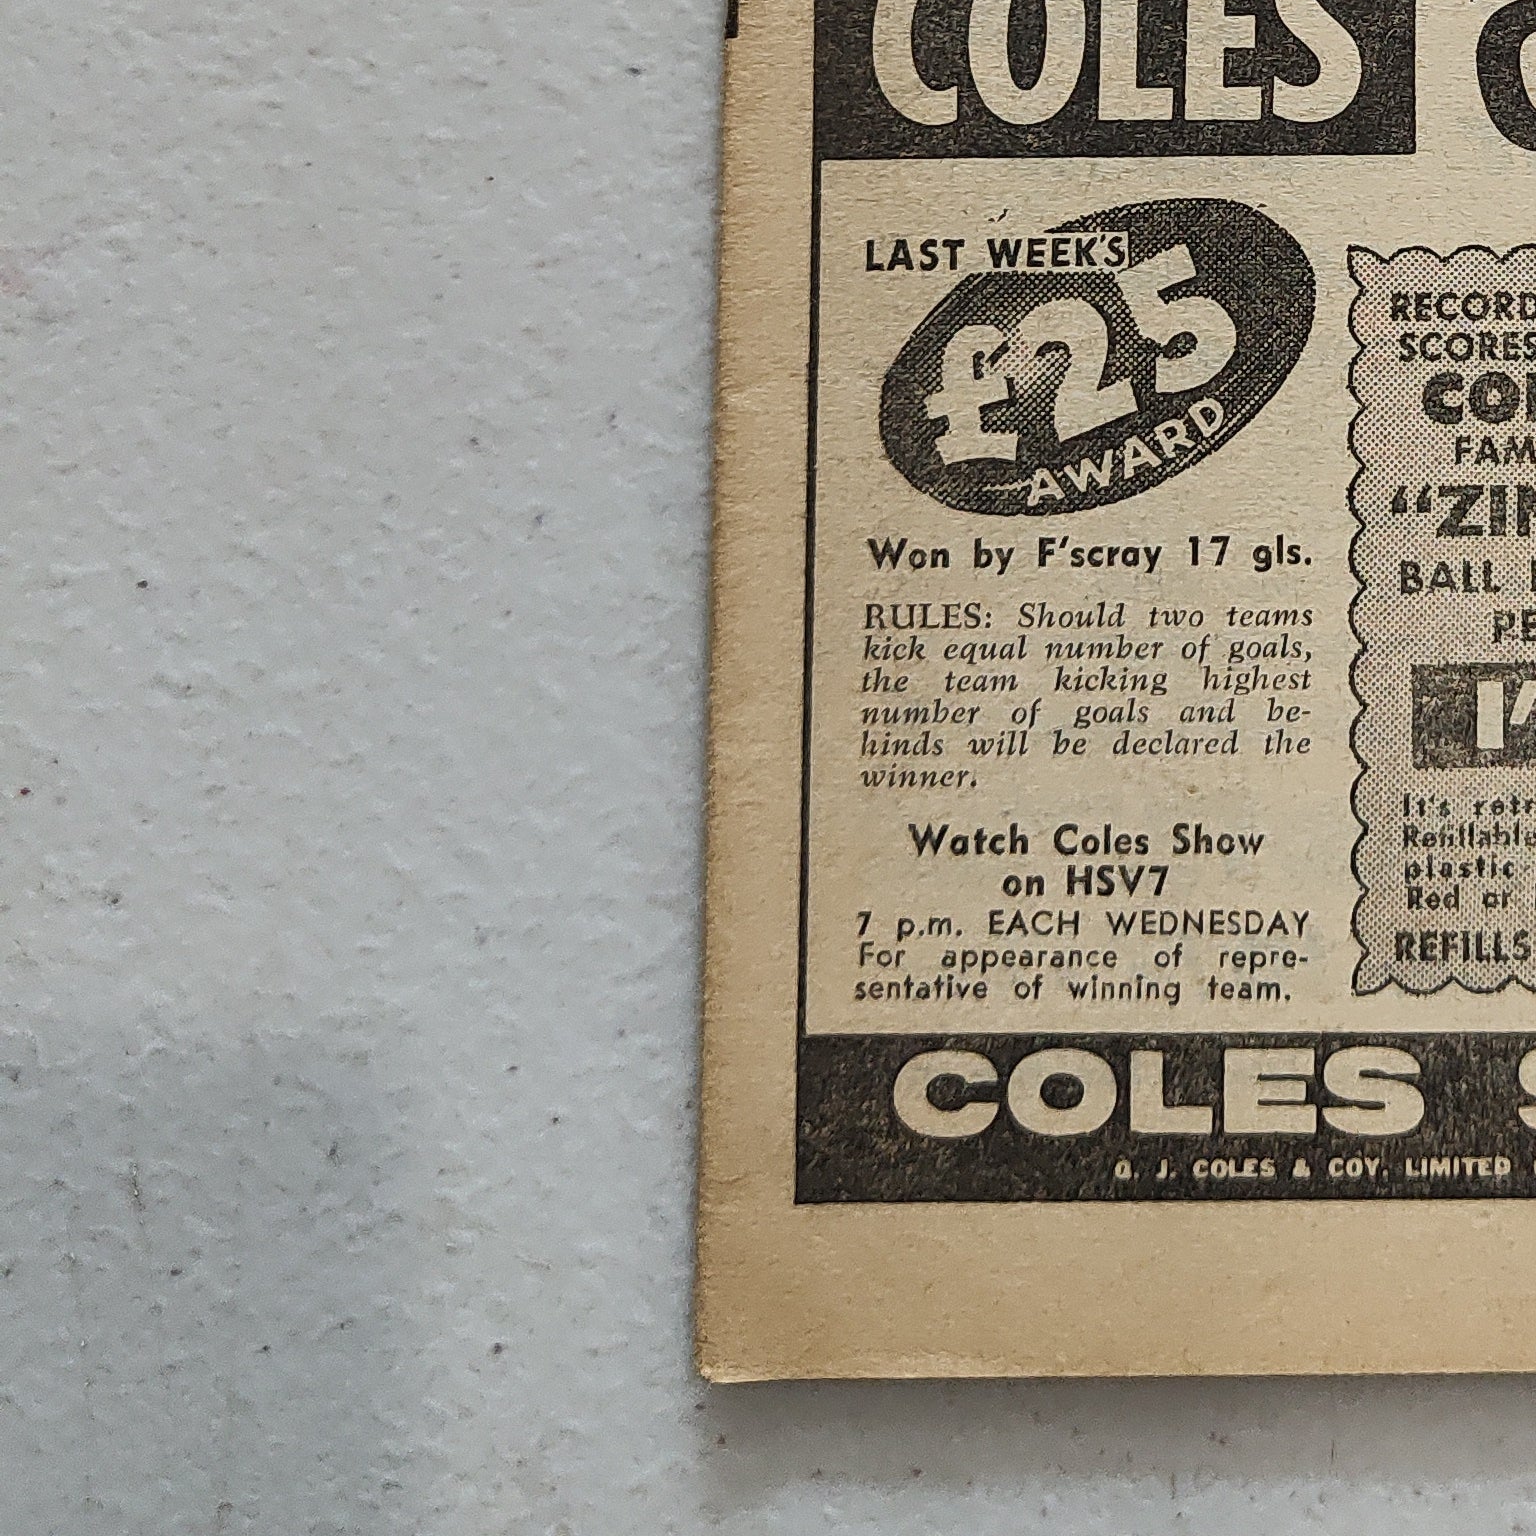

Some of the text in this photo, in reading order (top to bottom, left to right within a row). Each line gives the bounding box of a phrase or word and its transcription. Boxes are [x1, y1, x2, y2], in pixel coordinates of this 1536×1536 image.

[866, 234, 1126, 272] LAST WEEK'S
[923, 243, 1238, 465] £25
[1026, 396, 1227, 507] AWARD
[866, 534, 1313, 575] Won by F'scray 17 gls.
[1400, 561, 1500, 594] BALL
[864, 602, 1314, 630] RULES: Should two teams
[863, 634, 1313, 665] kick equal number of goals,
[861, 665, 1312, 696] the team kicking highest
[861, 696, 1311, 729] number of goals and be-
[861, 729, 1311, 758] hinds will be declared the
[861, 766, 979, 788] winner.
[1402, 793, 1450, 818] It's
[909, 823, 1266, 858] Watch Coles Show
[1003, 864, 1169, 896] on HSV7
[1404, 856, 1515, 884] plastic
[1407, 885, 1459, 910] Red
[1482, 889, 1511, 909] or
[857, 909, 1310, 942] 7 p.m. EACH WEDNESDAY
[858, 942, 1309, 973] For appearance of repre-
[1394, 930, 1531, 962] REFILLS
[855, 974, 1292, 1006] sentative of winning team.
[893, 1044, 1425, 1138] COLES
[1154, 1160, 1177, 1179] J.
[1192, 1159, 1276, 1179] COLES
[1292, 1160, 1311, 1178] &
[1328, 1158, 1389, 1178] COY.
[1404, 1158, 1511, 1178] LIMITED
